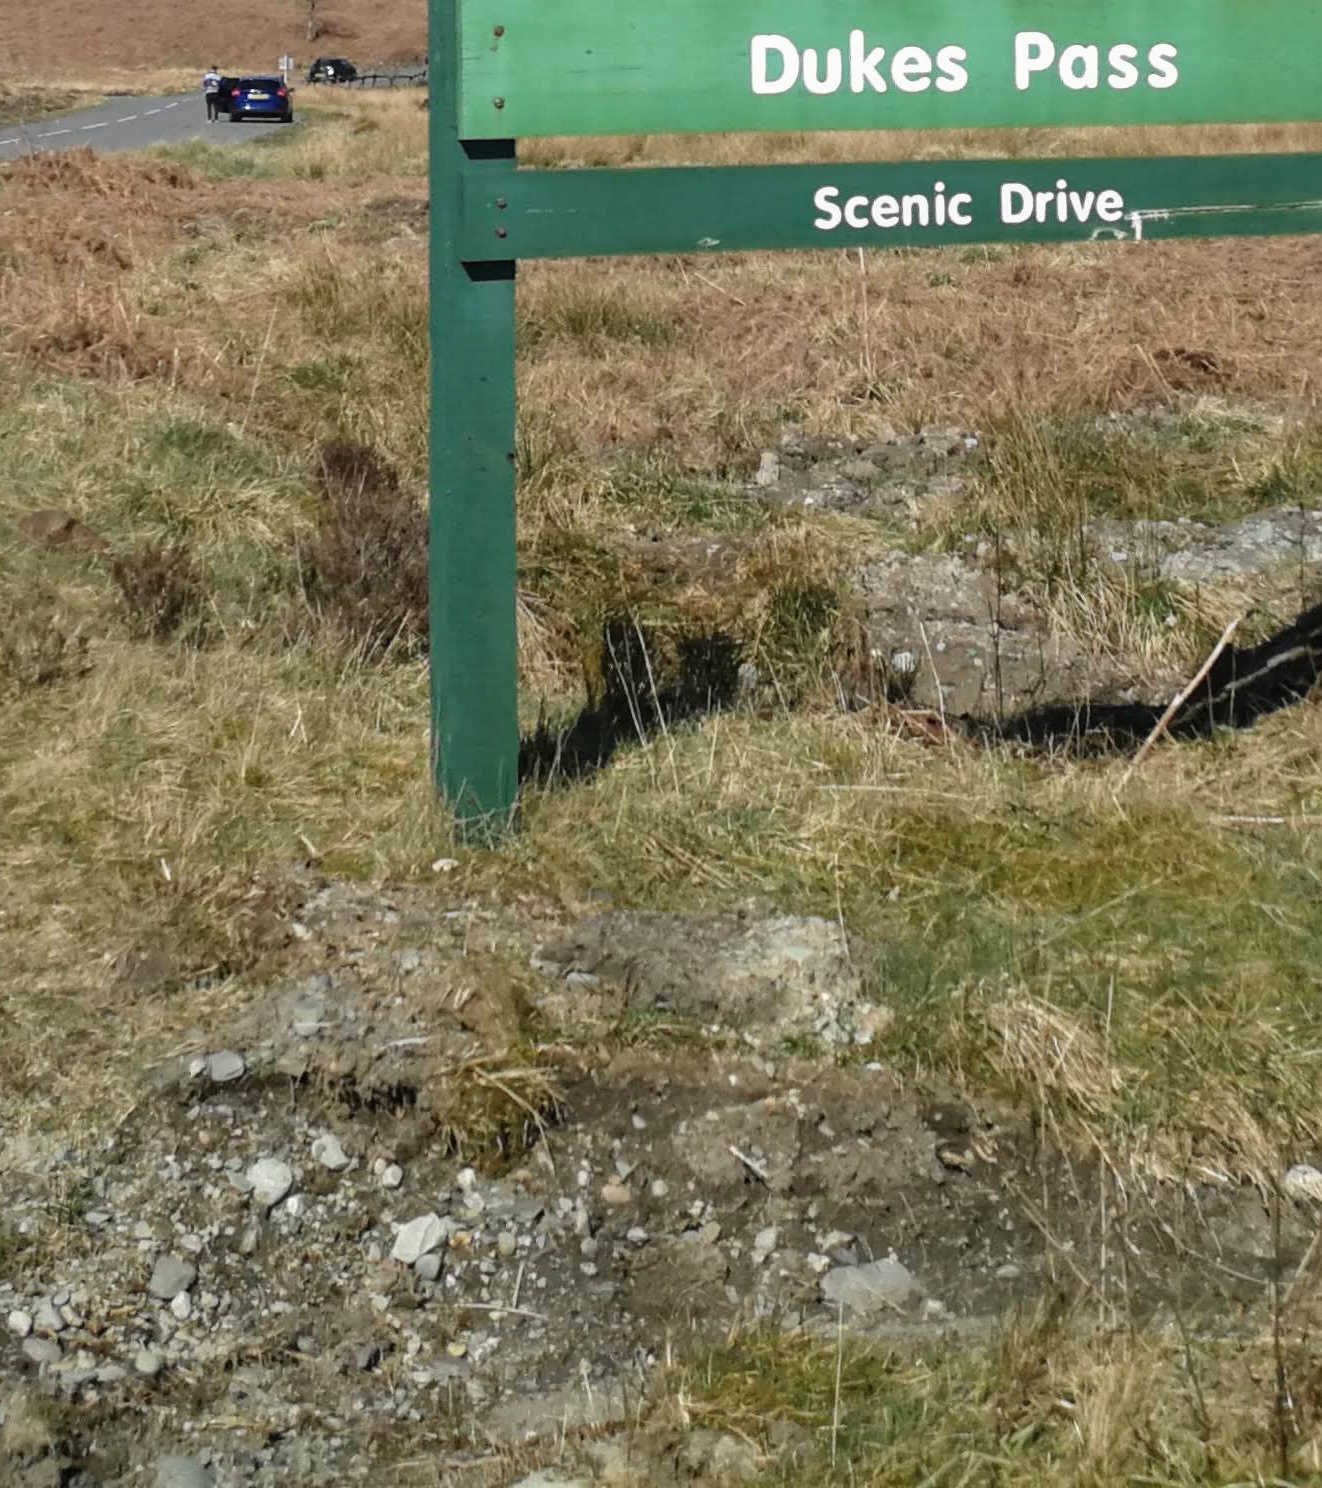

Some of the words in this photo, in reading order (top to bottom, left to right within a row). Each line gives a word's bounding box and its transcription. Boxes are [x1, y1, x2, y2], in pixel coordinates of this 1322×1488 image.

[750, 29, 969, 95] Dukes
[1014, 31, 1179, 93] Pass
[813, 180, 973, 231] Scenic
[1000, 178, 1124, 224] Drive
